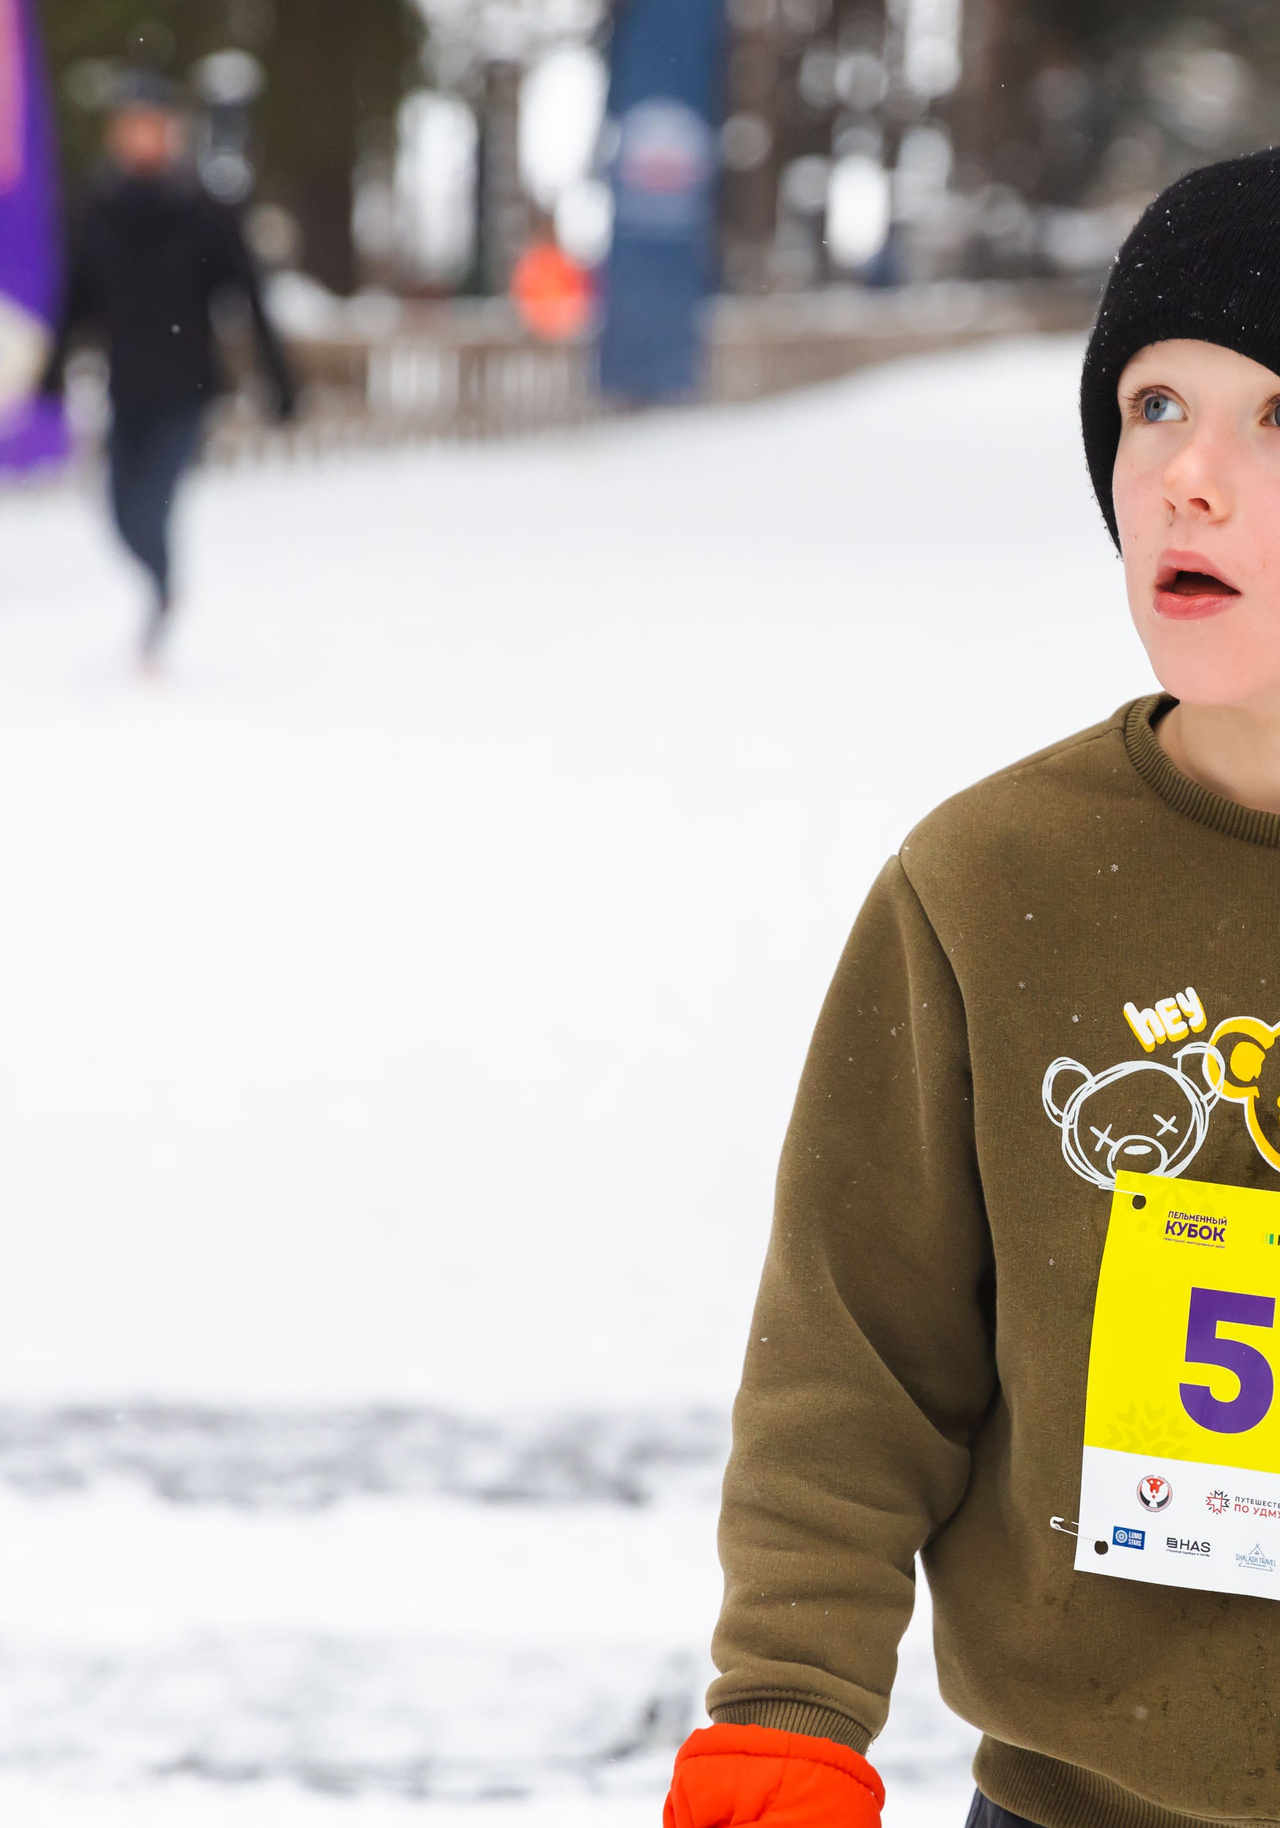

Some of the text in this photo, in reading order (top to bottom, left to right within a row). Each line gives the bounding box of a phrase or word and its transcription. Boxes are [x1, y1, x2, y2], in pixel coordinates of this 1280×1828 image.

[1167, 1210, 1228, 1226] ПЕЛЬМЕННЫЙ
[1164, 1219, 1226, 1243] КУБОК
[1234, 1503, 1249, 1514] ПО
[1179, 1538, 1212, 1554] HAS
